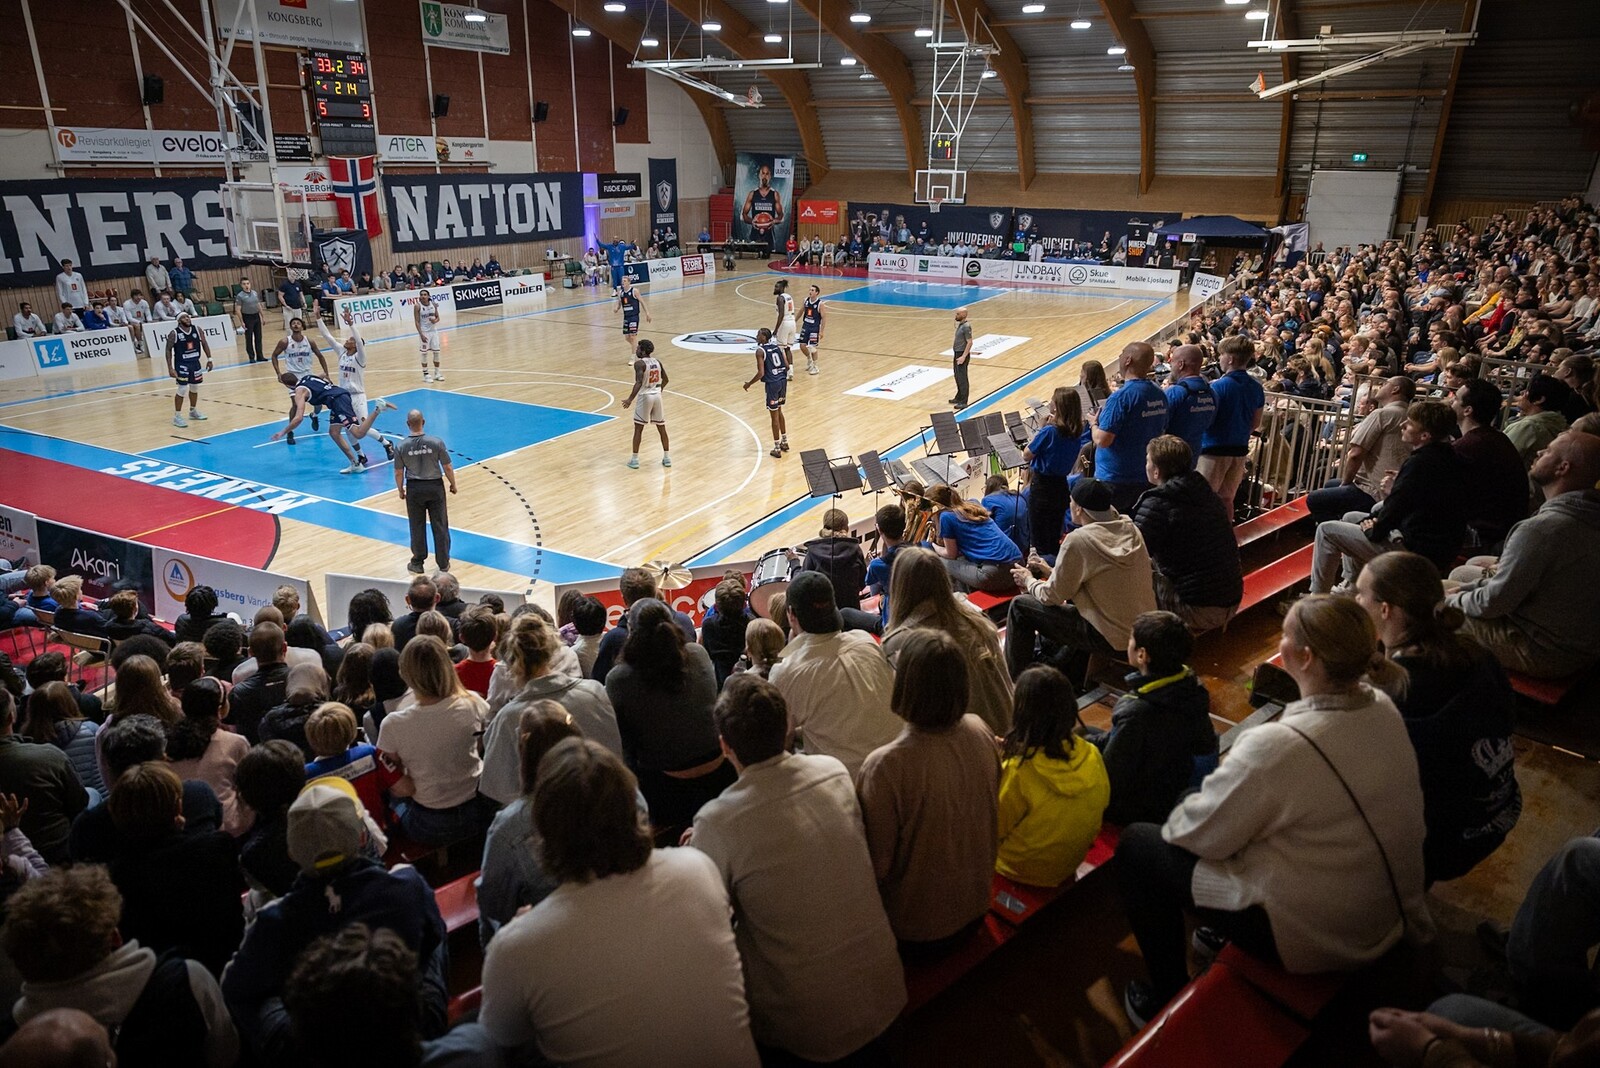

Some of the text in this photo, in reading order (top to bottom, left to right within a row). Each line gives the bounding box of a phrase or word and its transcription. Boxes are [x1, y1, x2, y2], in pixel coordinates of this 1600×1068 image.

[267, 11, 323, 28] KONGSBERG
[317, 58, 332, 72] 33
[350, 61, 364, 75] 34
[319, 102, 370, 117] 5 3
[77, 135, 152, 148] Revisorkollegiet
[388, 137, 427, 152] ATEA
[390, 182, 562, 242] NATION
[604, 206, 631, 214] POWER
[1128, 240, 1147, 249] MINERS
[1128, 247, 1144, 256] SHOP
[875, 258, 889, 267] ALL
[889, 259, 897, 267] IN
[1017, 264, 1062, 276] LINDBAK
[1089, 269, 1110, 278] Skue
[505, 285, 543, 297] POWER
[341, 296, 393, 313] SIEMENS
[406, 293, 450, 306] INTPORT
[70, 333, 128, 349] NOTODDEN
[74, 347, 111, 361] ENERGI
[771, 352, 782, 368] 0
[649, 370, 660, 384] 23
[98, 459, 321, 514] MINERS
[70, 548, 121, 581] Akari
